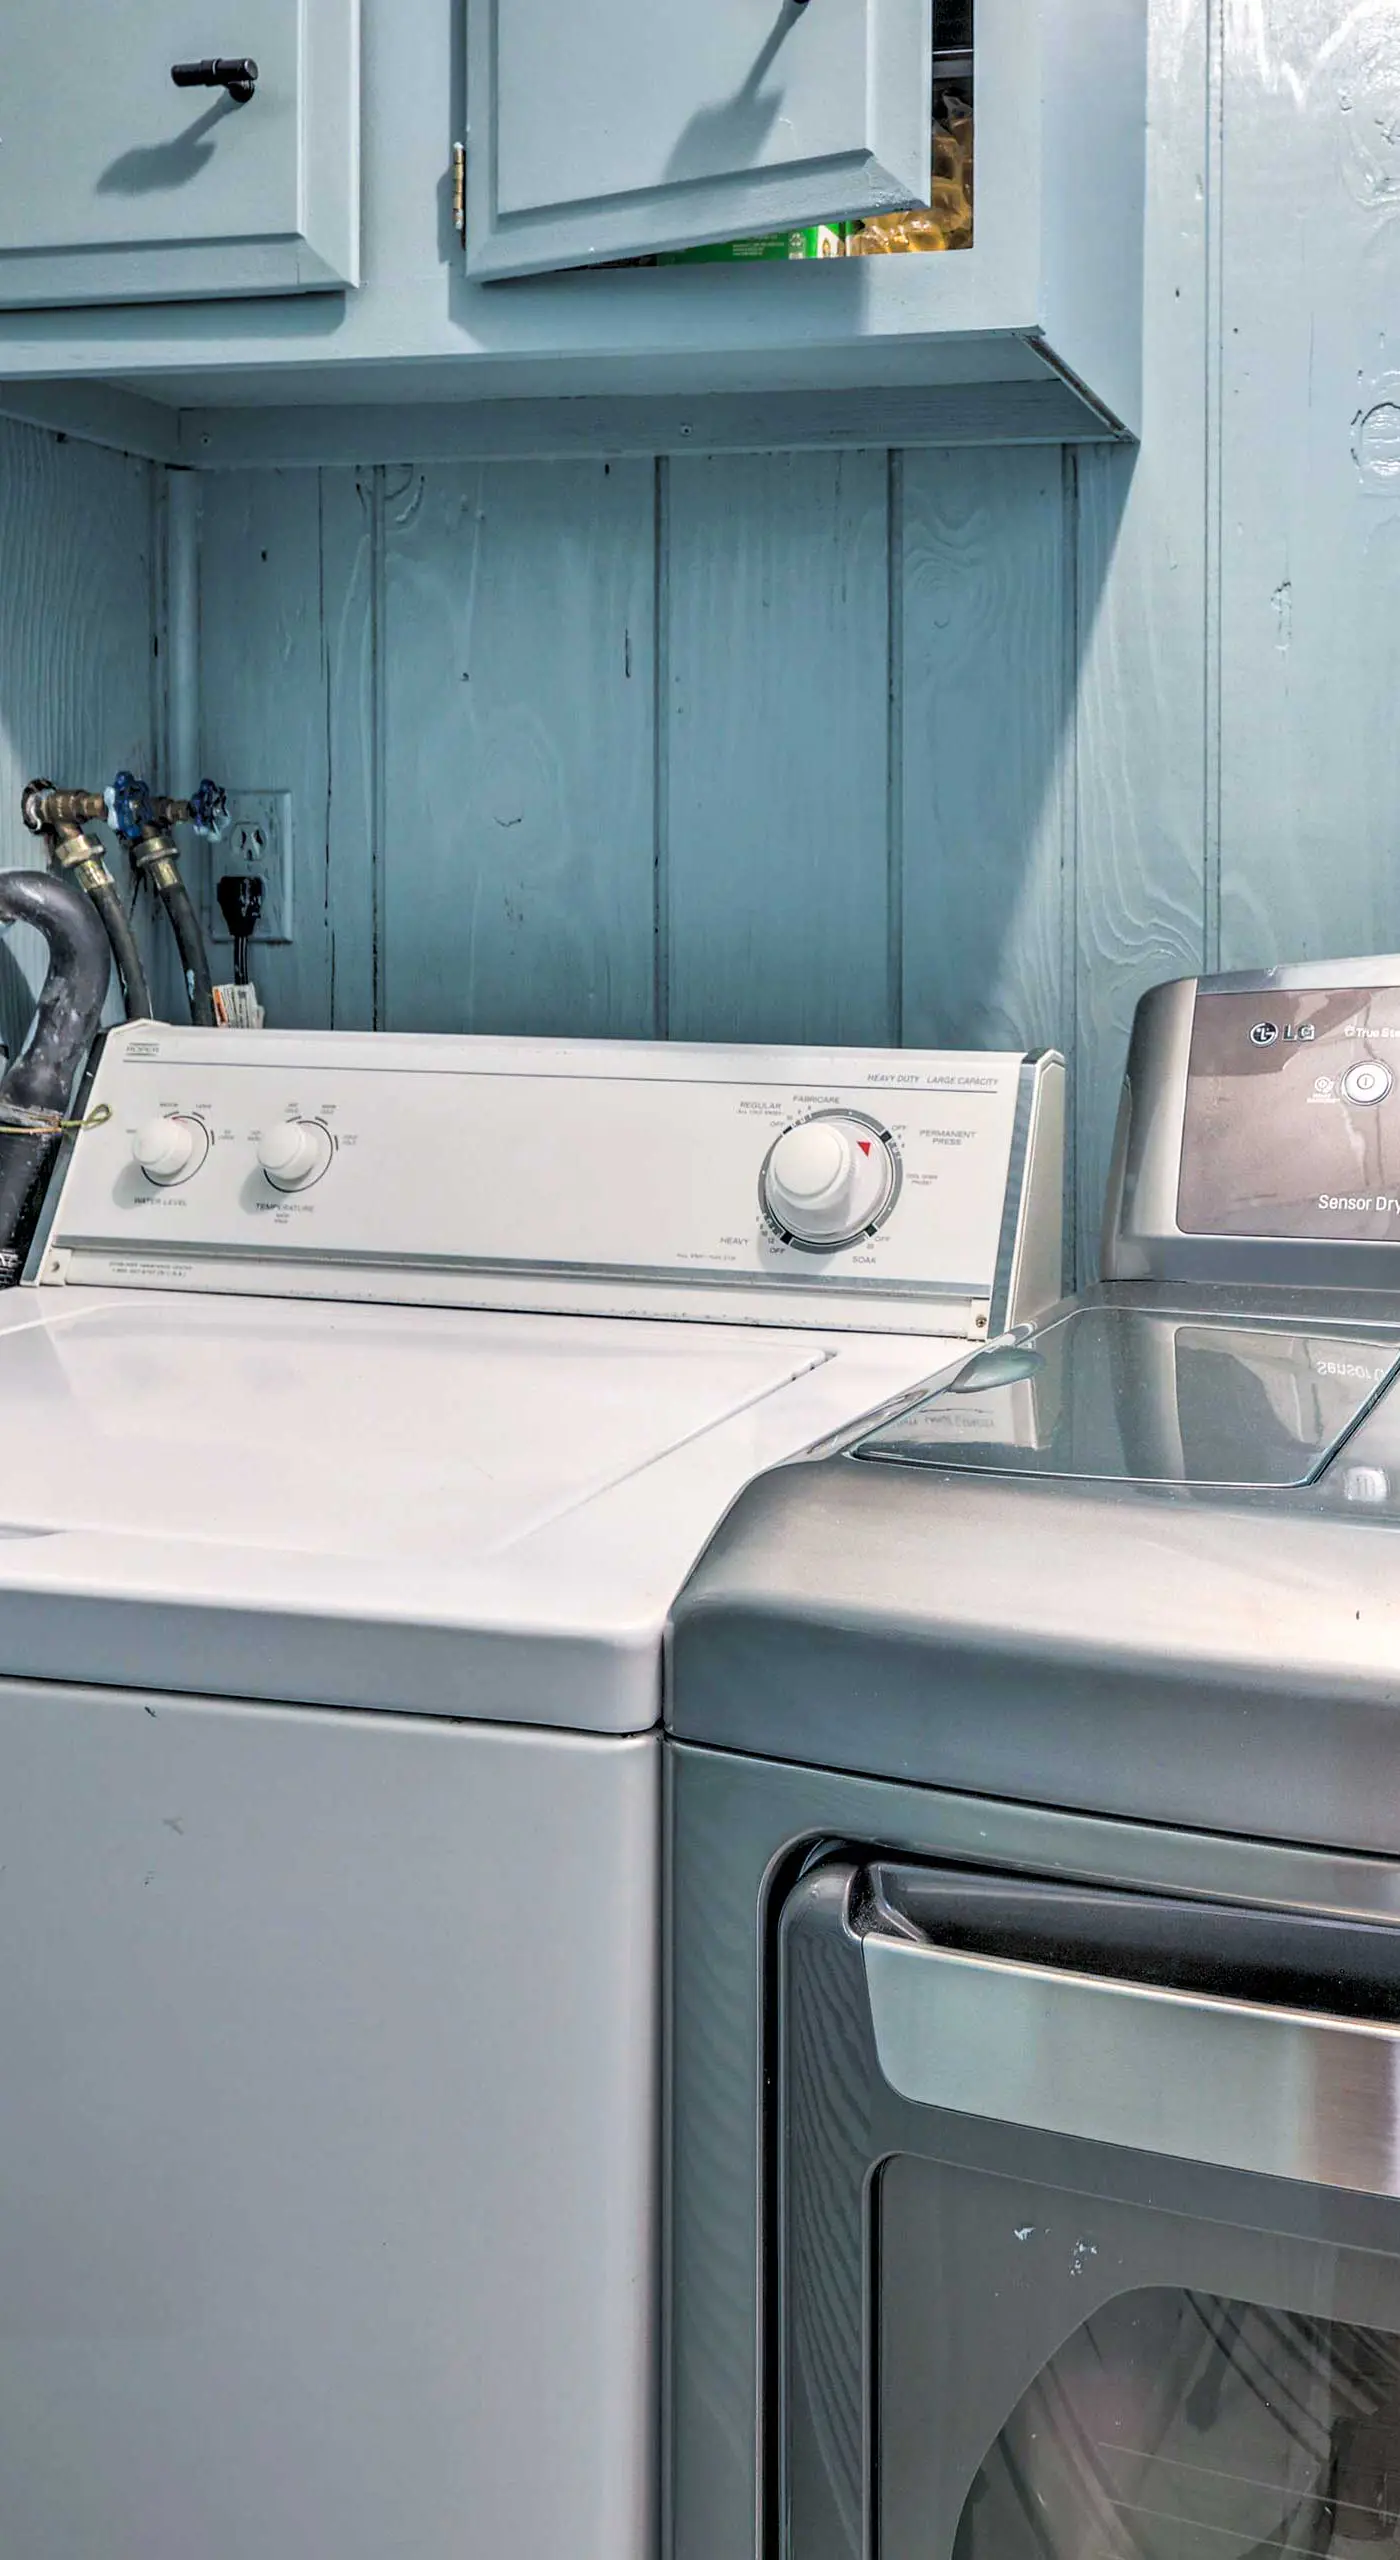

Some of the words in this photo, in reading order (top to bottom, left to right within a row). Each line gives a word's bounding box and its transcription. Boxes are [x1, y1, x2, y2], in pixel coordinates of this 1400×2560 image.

[1282, 1024, 1315, 1042] LG
[1355, 1027, 1380, 1038] True
[867, 1073, 896, 1082] HEAVY
[897, 1074, 920, 1083] DUTY
[926, 1075, 957, 1085] LARGE
[957, 1076, 999, 1086] CAPACITY
[740, 1101, 782, 1110] REGULAR
[919, 1129, 976, 1139] PERMANENT
[932, 1137, 962, 1146] PRESS
[163, 1198, 187, 1207] LEVEL
[1318, 1194, 1372, 1211] Sensor
[719, 1237, 748, 1245] HEAVY
[852, 1255, 877, 1264] SOAK
